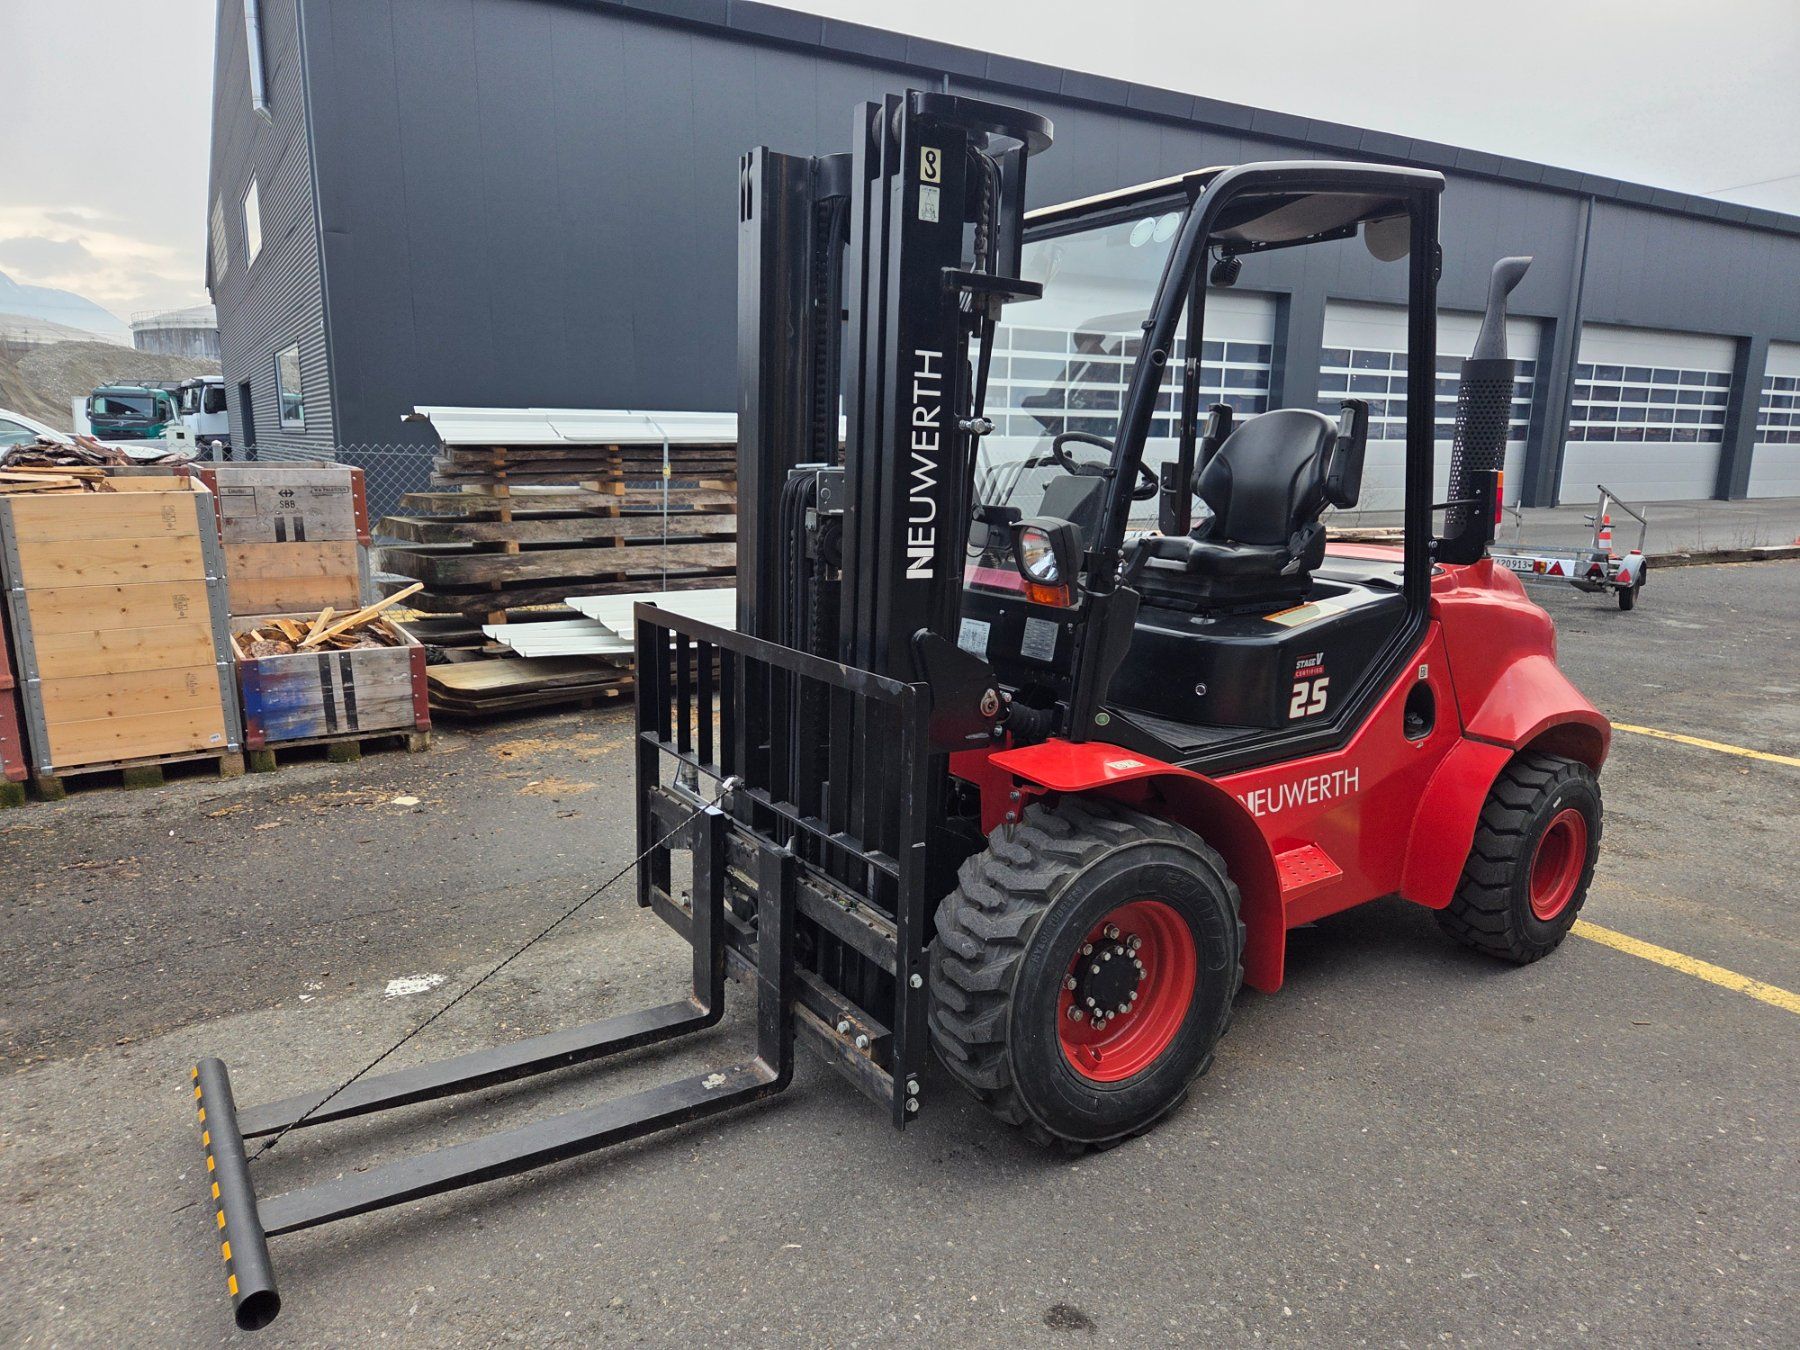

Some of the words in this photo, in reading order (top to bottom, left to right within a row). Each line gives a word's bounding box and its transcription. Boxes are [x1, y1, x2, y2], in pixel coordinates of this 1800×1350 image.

[906, 349, 943, 579] NEUWERTH
[279, 500, 296, 509] SBB
[1295, 658, 1317, 669] STAGE
[1316, 652, 1324, 665] V
[1288, 677, 1330, 719] 25
